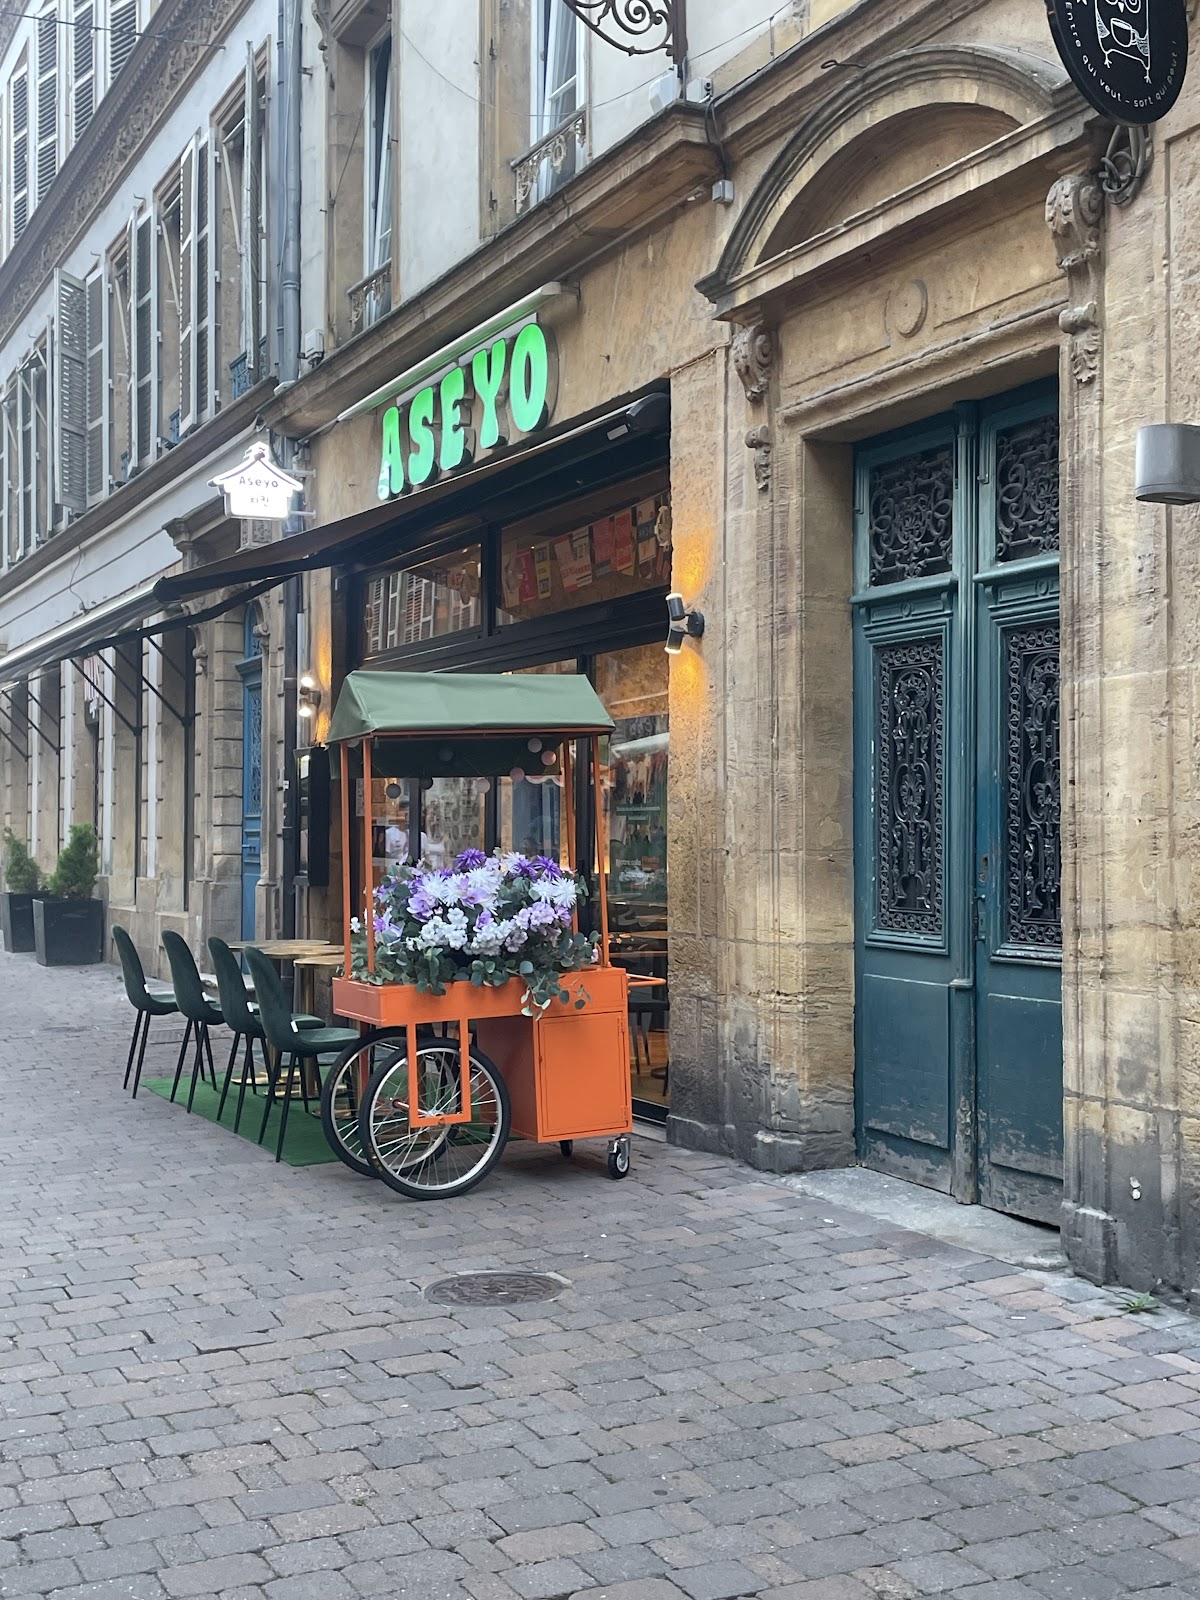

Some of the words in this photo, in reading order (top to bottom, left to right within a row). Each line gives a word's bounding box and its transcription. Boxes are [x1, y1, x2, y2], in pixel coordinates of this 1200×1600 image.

[1065, 2, 1081, 47] Entre
[1082, 55, 1097, 76] qui
[1100, 78, 1121, 101] veut
[1133, 96, 1153, 107] sort
[1155, 84, 1167, 100] qui
[1167, 52, 1178, 84] peut
[377, 323, 548, 500] ASEYO
[239, 476, 279, 488] Aseyo
